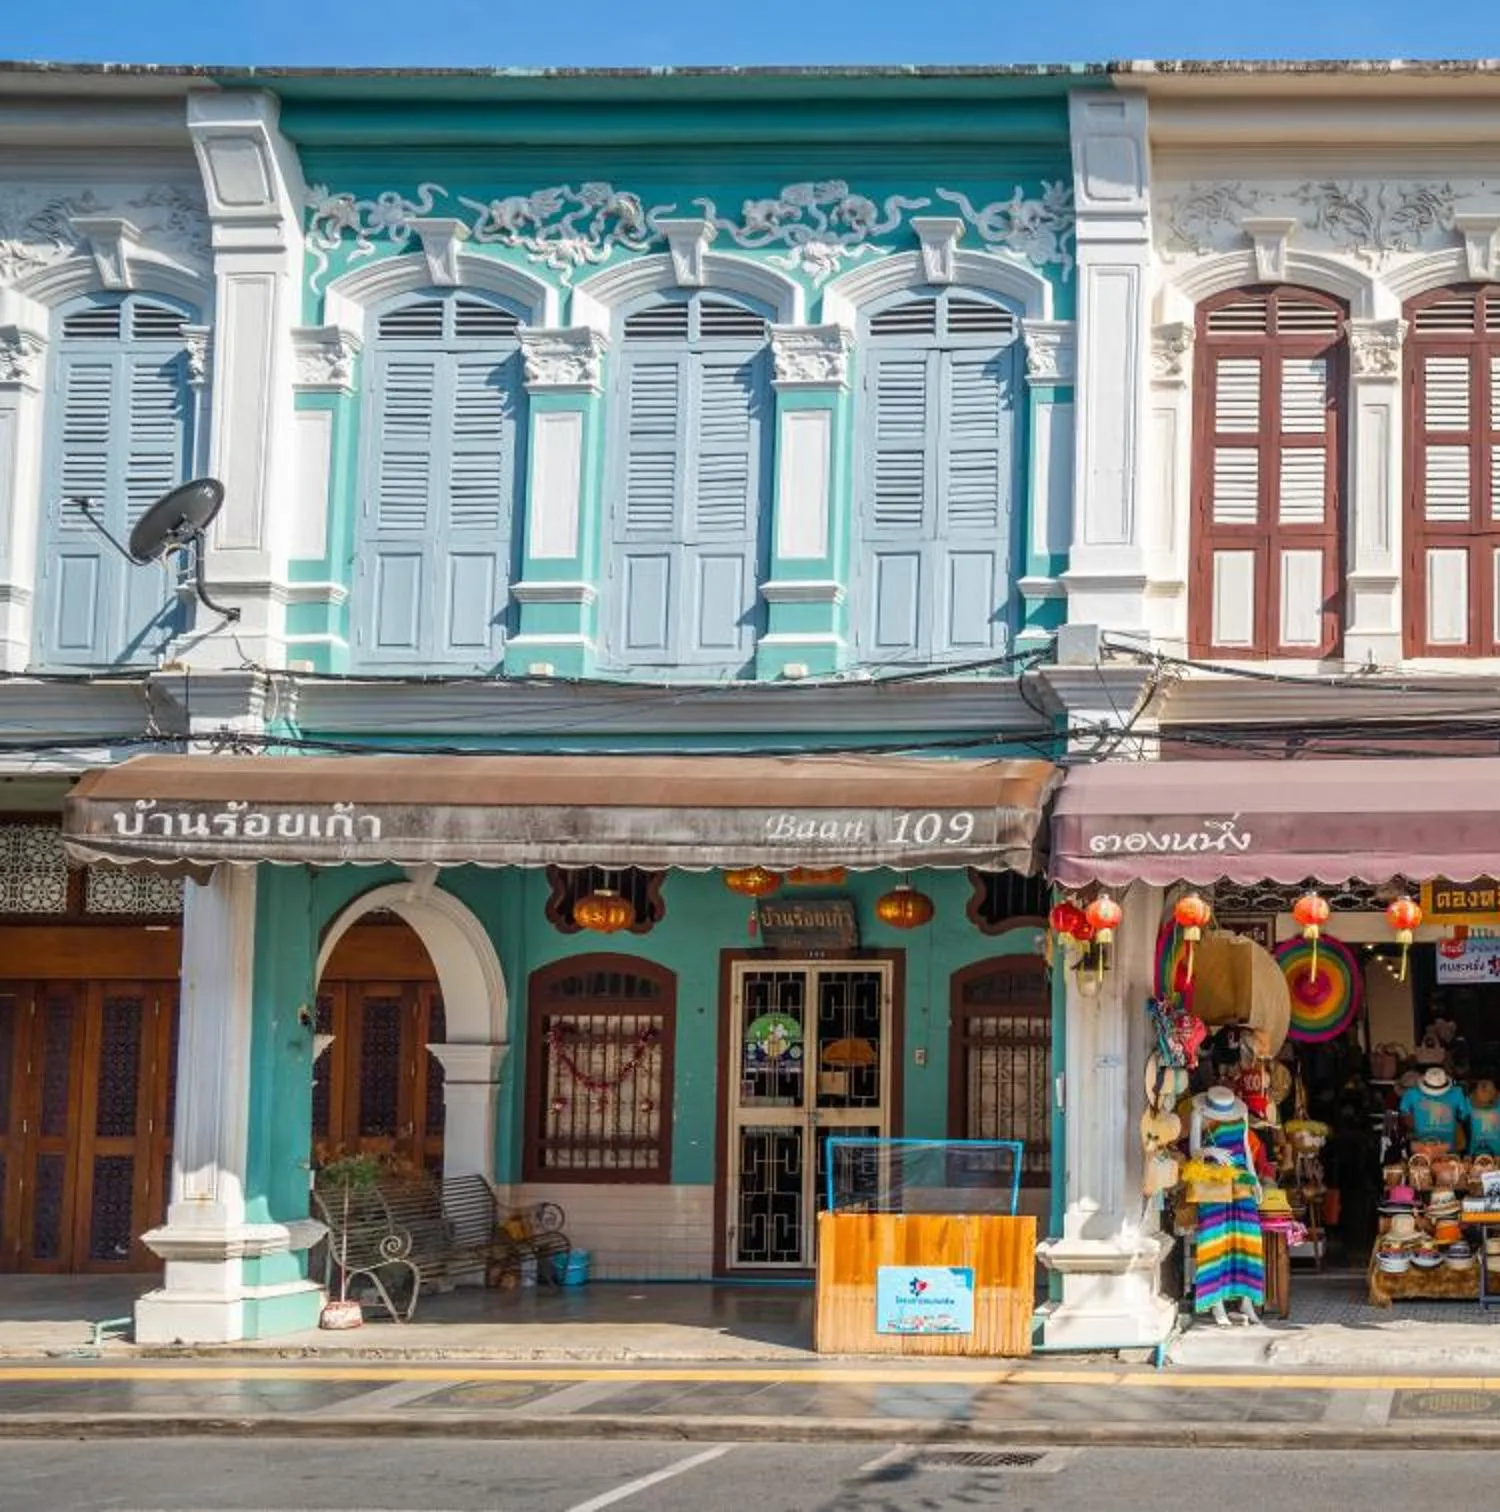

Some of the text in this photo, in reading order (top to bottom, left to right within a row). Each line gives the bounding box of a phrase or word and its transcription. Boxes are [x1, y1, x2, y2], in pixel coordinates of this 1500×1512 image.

[113, 799, 381, 839] บ้านร้อยเก้า
[766, 811, 975, 843] Baan 109
[1089, 812, 1251, 852] ตองหนึ่ง
